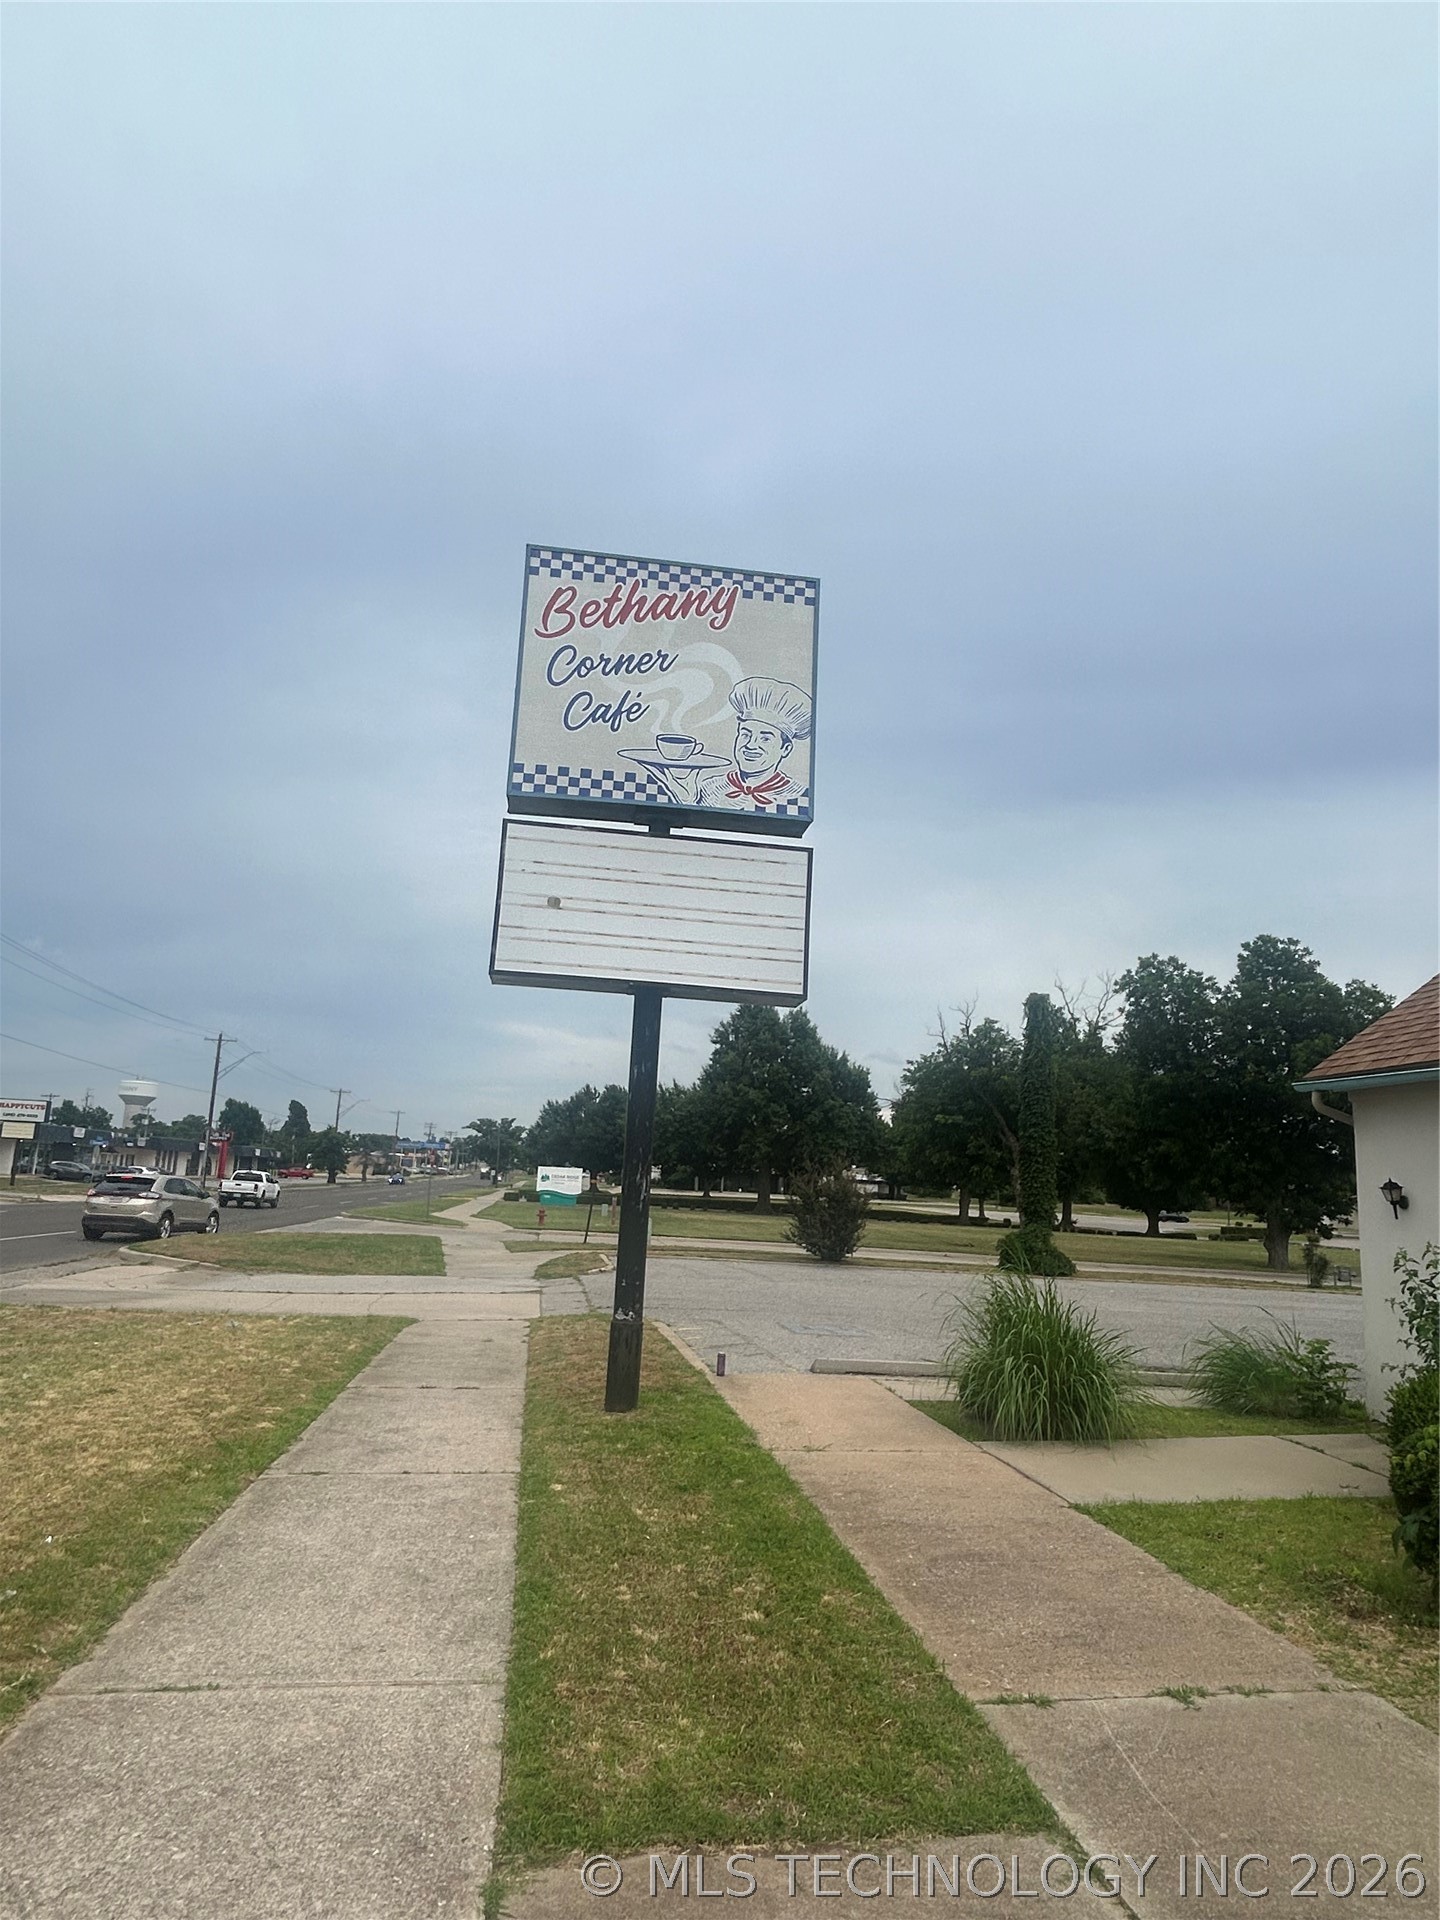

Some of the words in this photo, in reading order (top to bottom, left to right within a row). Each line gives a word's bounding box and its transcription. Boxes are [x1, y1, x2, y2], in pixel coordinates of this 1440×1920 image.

[534, 578, 740, 638] Bethany
[546, 644, 679, 687] Corner
[563, 690, 650, 732] Café
